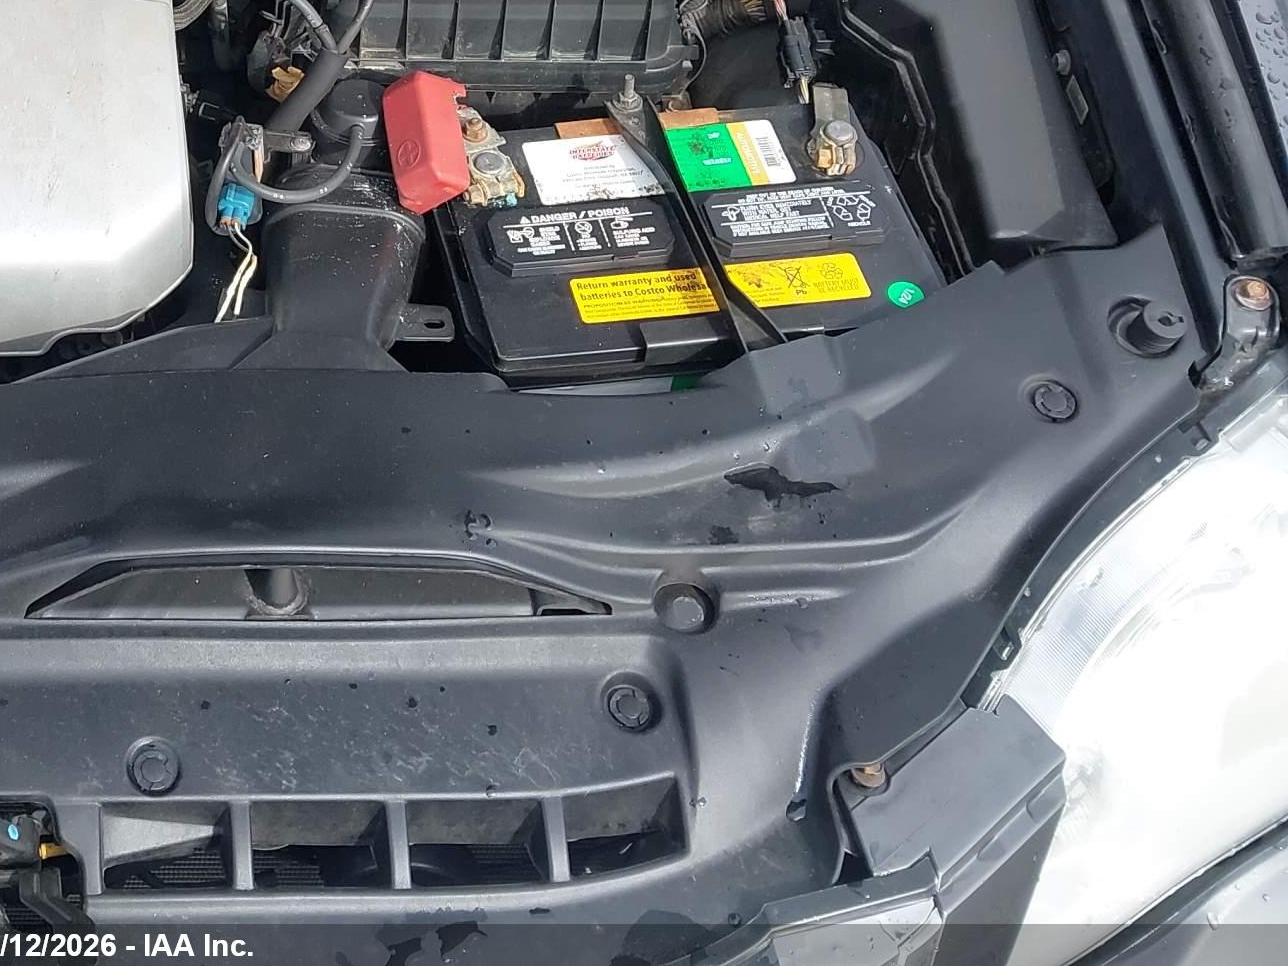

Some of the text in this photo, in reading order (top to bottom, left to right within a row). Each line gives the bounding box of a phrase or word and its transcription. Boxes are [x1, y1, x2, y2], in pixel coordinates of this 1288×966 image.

[569, 144, 617, 155] INTERSTATE
[530, 211, 578, 224] DANGER
[588, 206, 630, 218] POISON
[576, 271, 697, 291] Return warranty and used
[580, 281, 708, 302] batteries to Costco Wholesa
[795, 288, 808, 297] Pb
